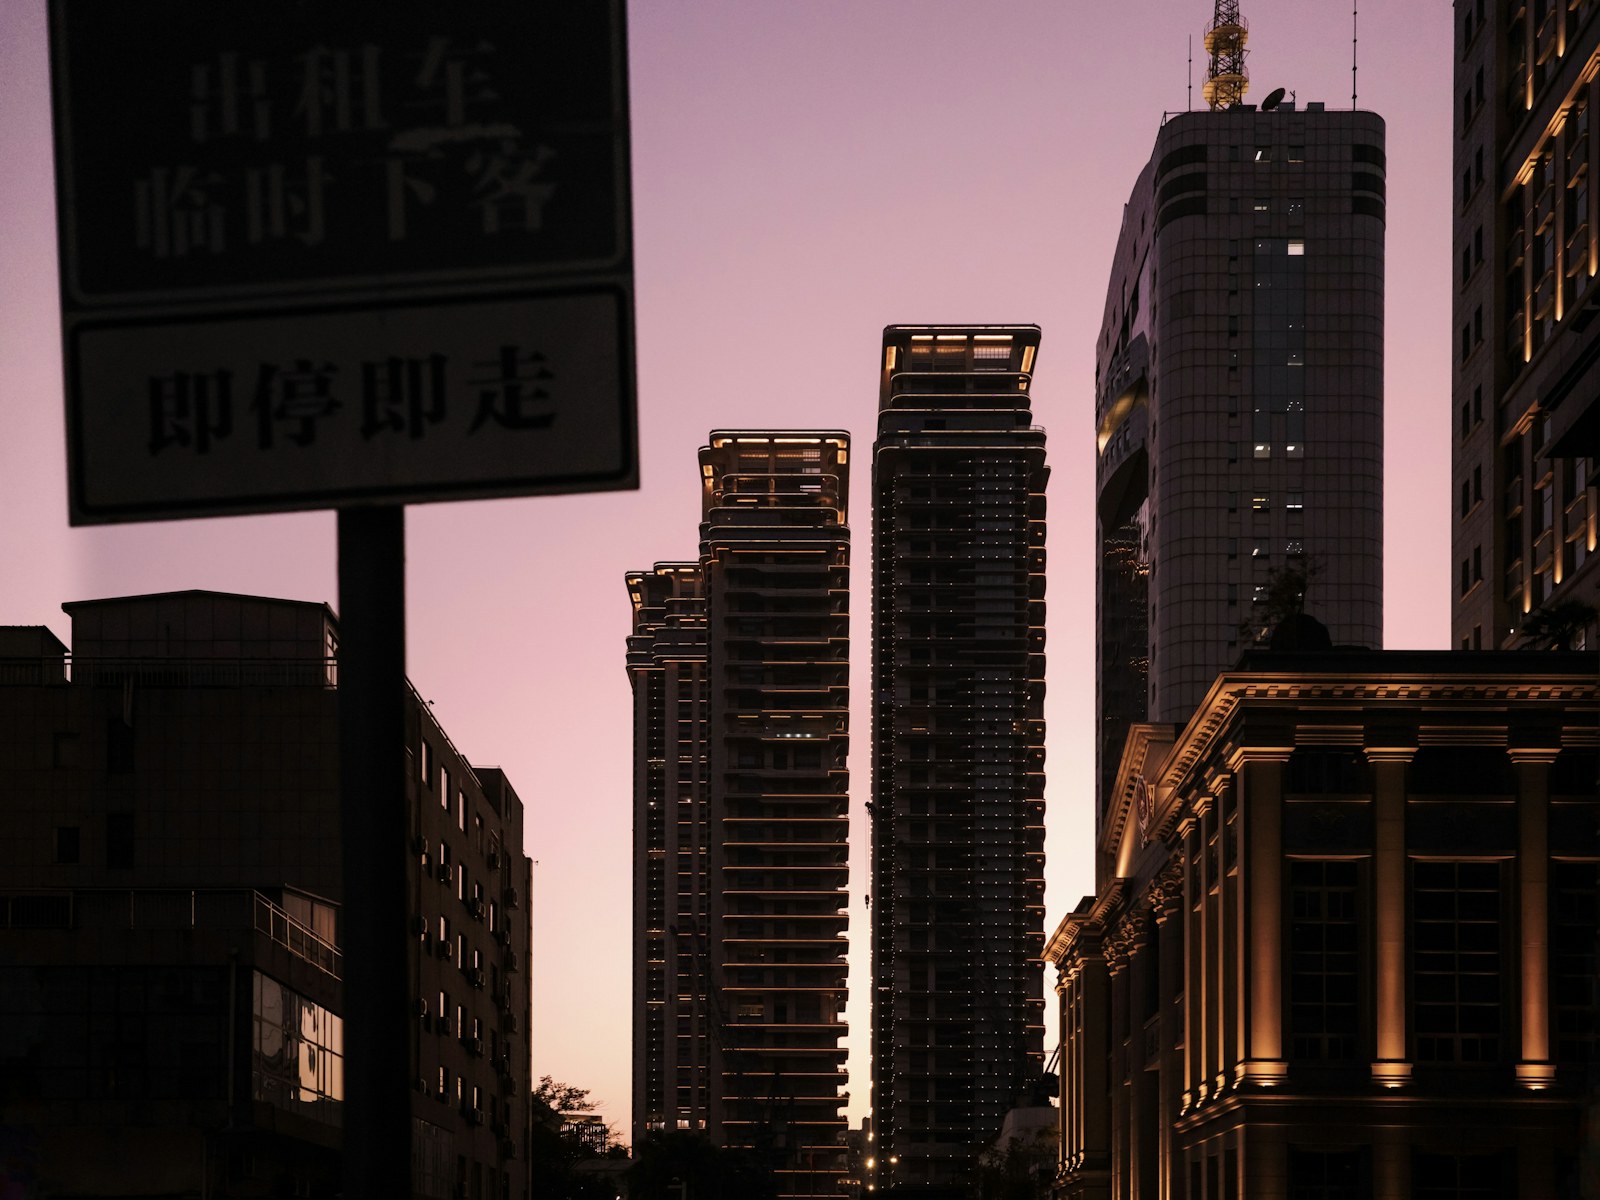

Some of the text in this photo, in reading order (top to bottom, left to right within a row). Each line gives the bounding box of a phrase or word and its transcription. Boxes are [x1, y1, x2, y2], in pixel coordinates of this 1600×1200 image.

[190, 35, 499, 142] 出租车
[133, 140, 559, 258] 临时下客
[146, 345, 558, 457] 即停即走
